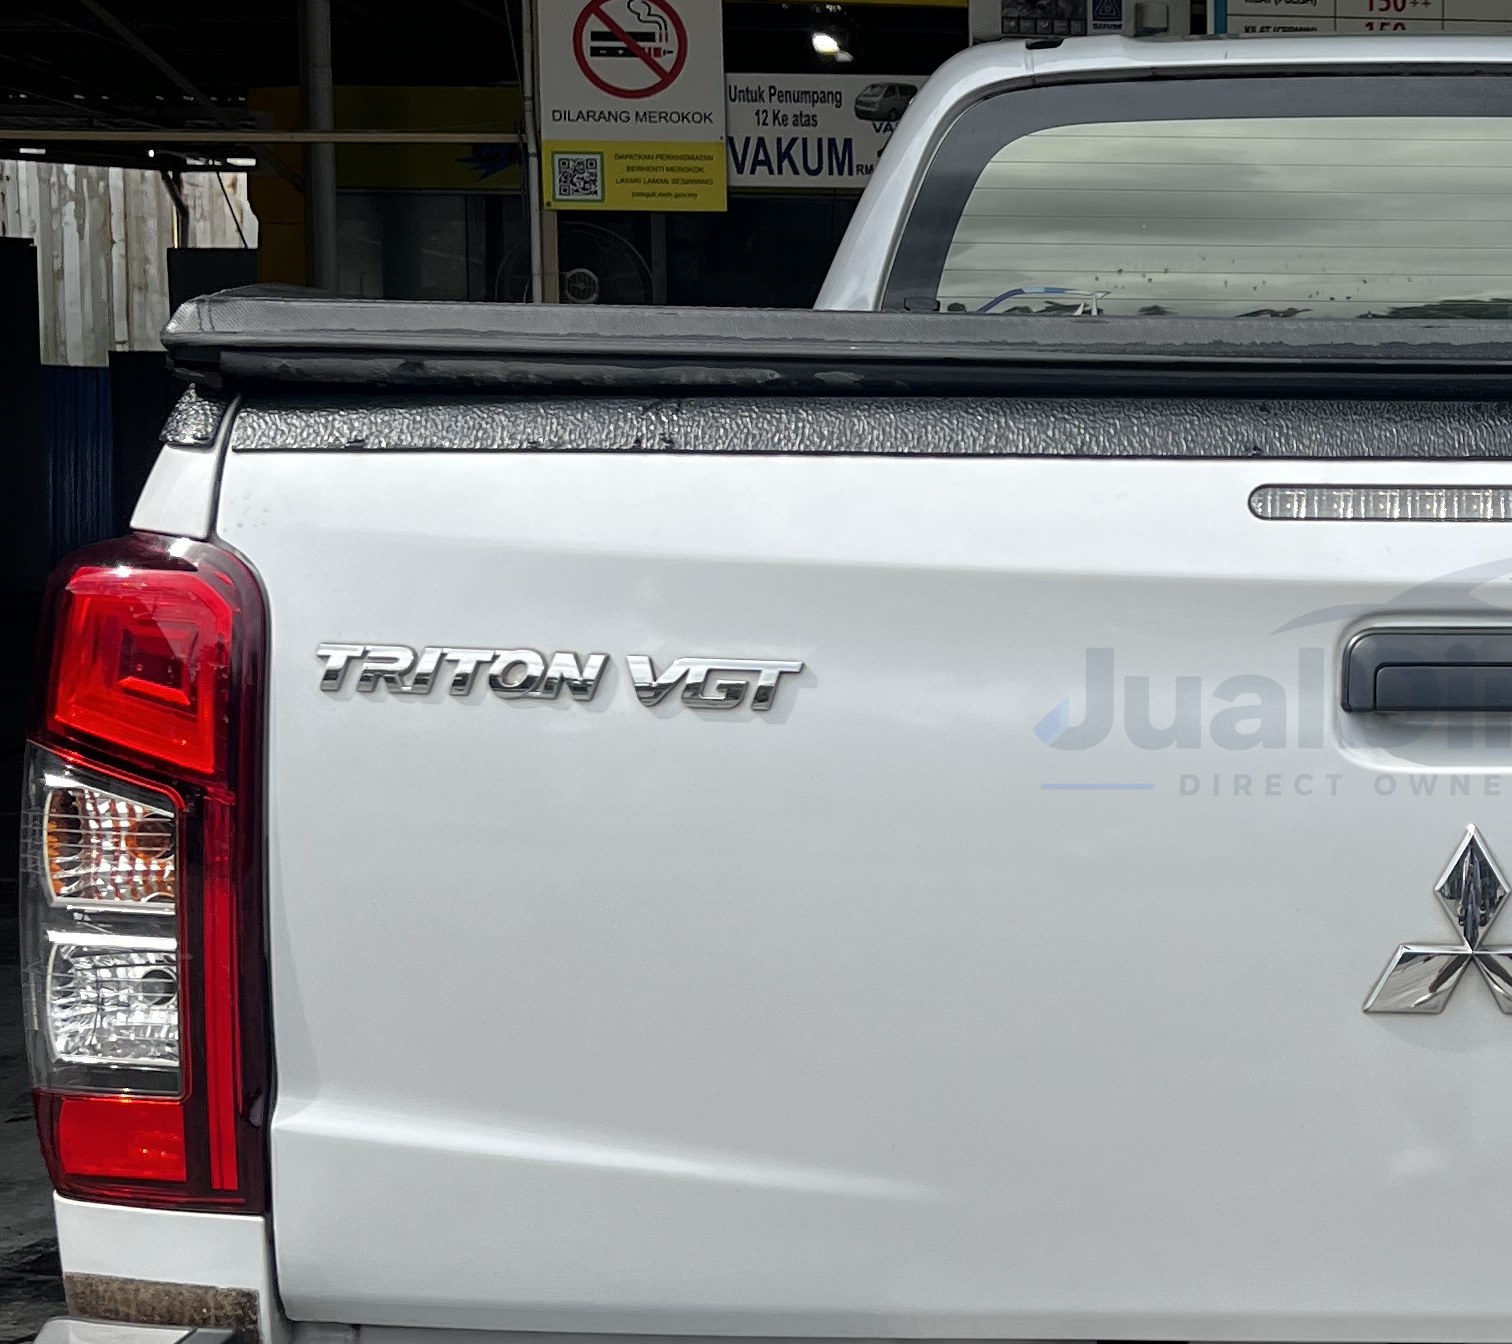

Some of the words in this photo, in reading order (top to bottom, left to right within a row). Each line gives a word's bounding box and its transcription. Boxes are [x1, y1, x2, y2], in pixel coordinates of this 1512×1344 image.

[728, 84, 765, 103] Untuk
[769, 85, 843, 108] Penumpang
[551, 109, 631, 124] DILARANG
[635, 110, 714, 125] MEROKOK
[755, 109, 769, 127] 12
[772, 109, 788, 127] Ke
[792, 110, 819, 127] atas
[727, 136, 854, 176] VAKUM
[316, 641, 611, 702] TRITON
[626, 654, 805, 711] VGT
